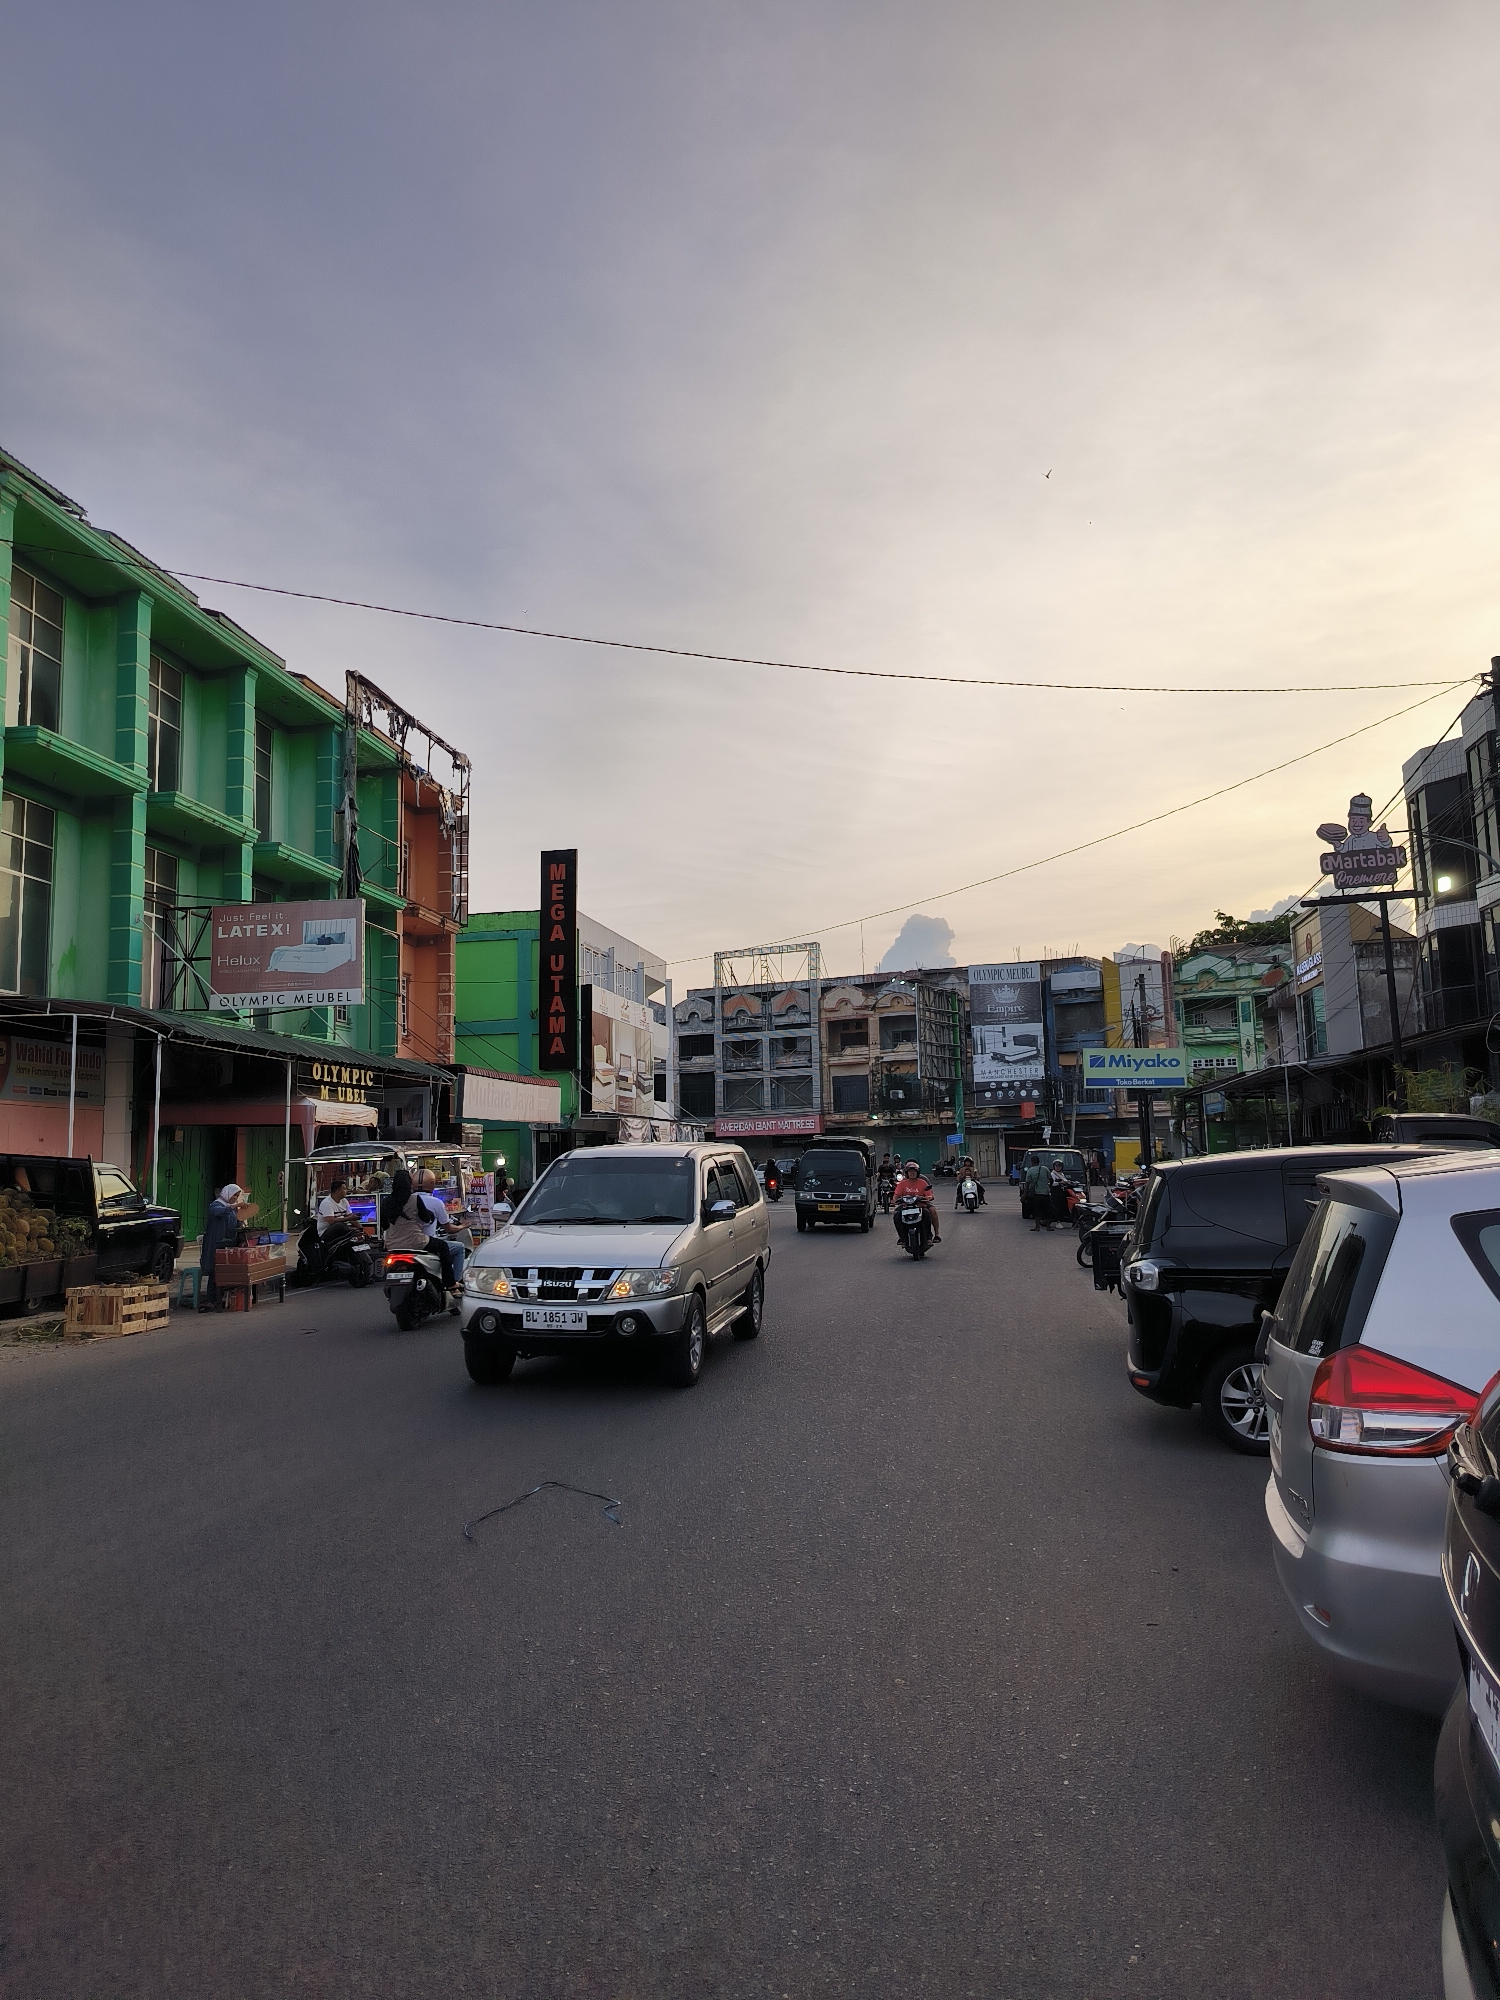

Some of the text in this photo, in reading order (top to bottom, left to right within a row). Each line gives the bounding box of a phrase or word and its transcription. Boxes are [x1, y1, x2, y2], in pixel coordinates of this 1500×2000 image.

[219, 911, 288, 923] Just Feel it.
[218, 923, 290, 939] LATEX!
[217, 954, 261, 967] Helux
[549, 863, 566, 1055] MEGA UTAMA
[973, 967, 1035, 982] OLYMPIC MEUBEL
[219, 991, 352, 1008] OLYMPIC MEUBEL
[986, 1003, 1025, 1017] Empire
[16, 1042, 53, 1064] Wahid
[1108, 1053, 1180, 1072] Miyako
[16, 1065, 31, 1075] Home
[312, 1062, 374, 1087] OLYMPIC
[980, 1068, 1039, 1076] MANCHESTER
[1116, 1078, 1156, 1086] Toko Berkat
[468, 1078, 535, 1115] Mutiara Jaya
[719, 1122, 754, 1132] AMERICAN
[777, 1119, 815, 1130] MATTRESS
[543, 1280, 572, 1288] ISUZU
[525, 1311, 584, 1324] BL 1851 JW
